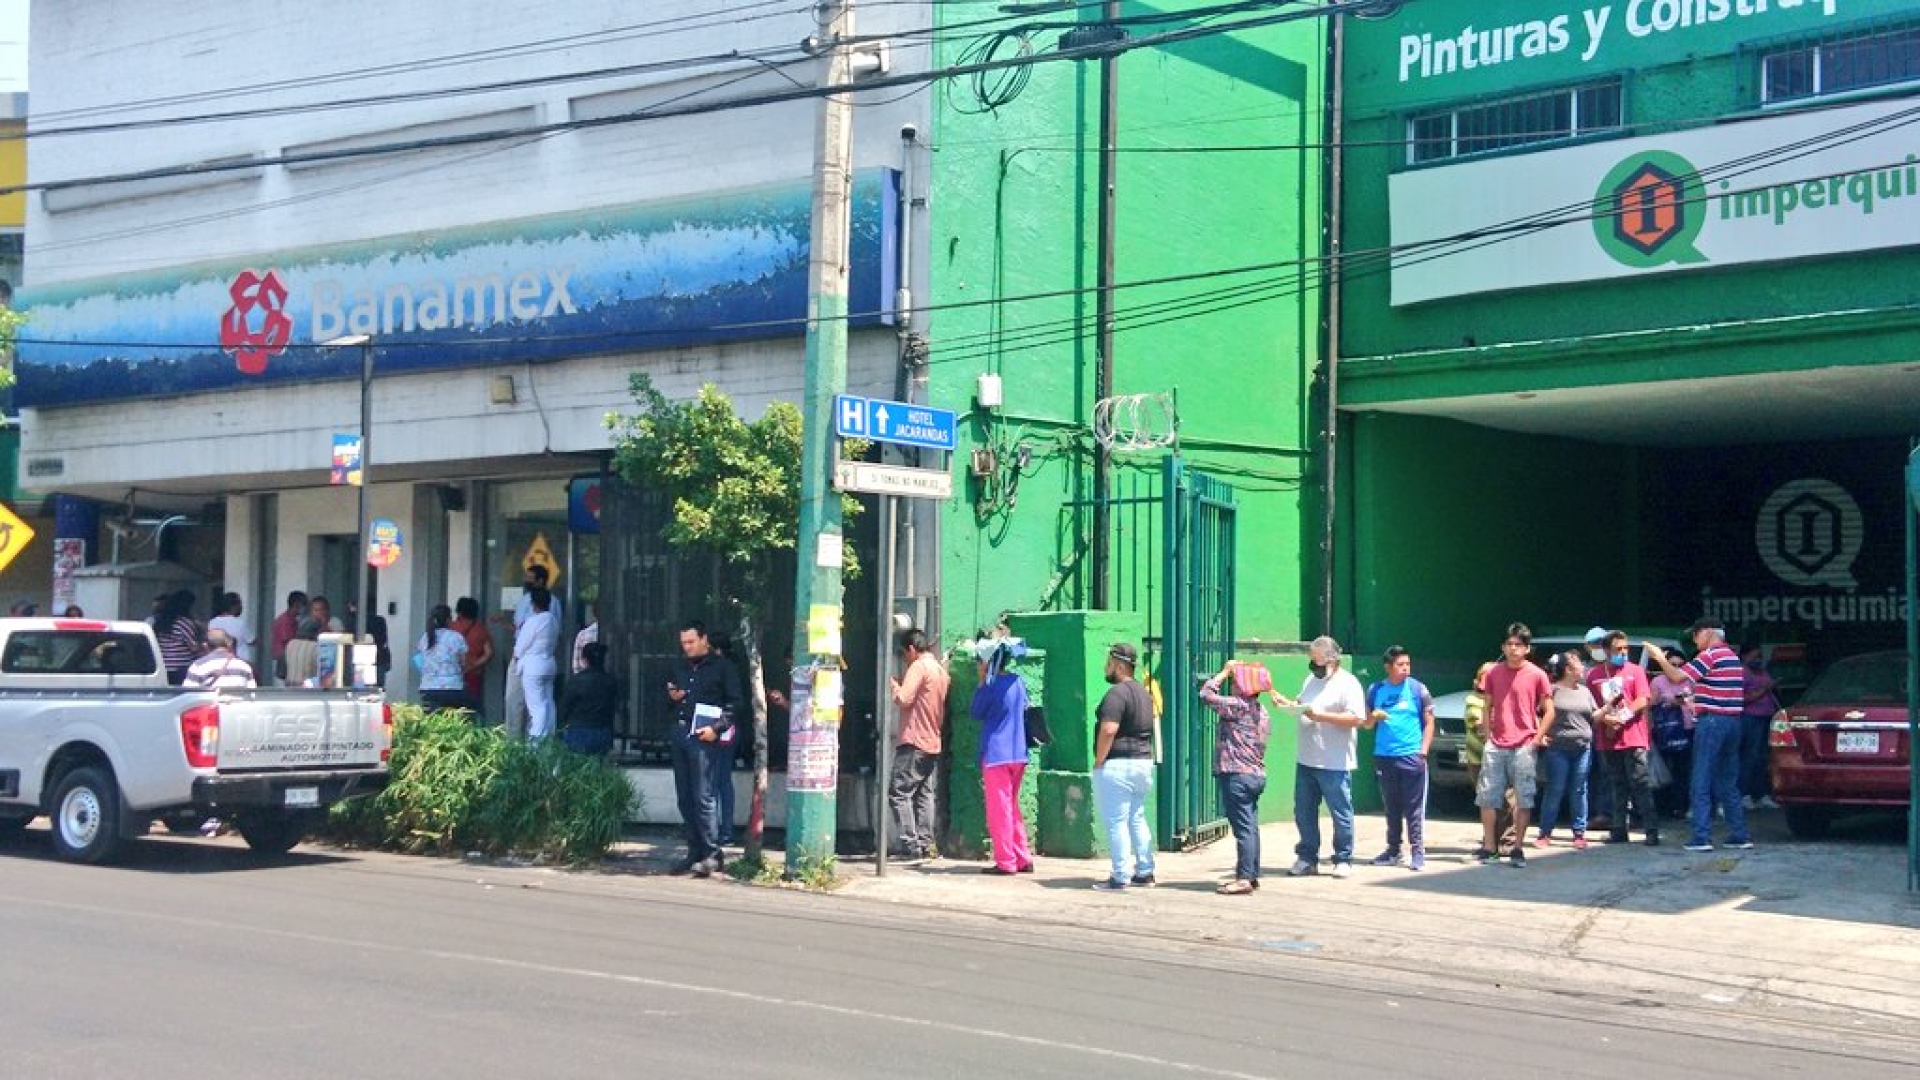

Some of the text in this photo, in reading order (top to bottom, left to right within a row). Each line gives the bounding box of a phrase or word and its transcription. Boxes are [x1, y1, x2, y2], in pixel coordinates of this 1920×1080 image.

[1399, 0, 1838, 82] Pinturas y Cons
[1720, 153, 1917, 225] imperqui
[311, 267, 579, 342] Banamex
[843, 400, 863, 431] H
[895, 425, 948, 442] JACARANDAS
[908, 411, 935, 427] HOTEL
